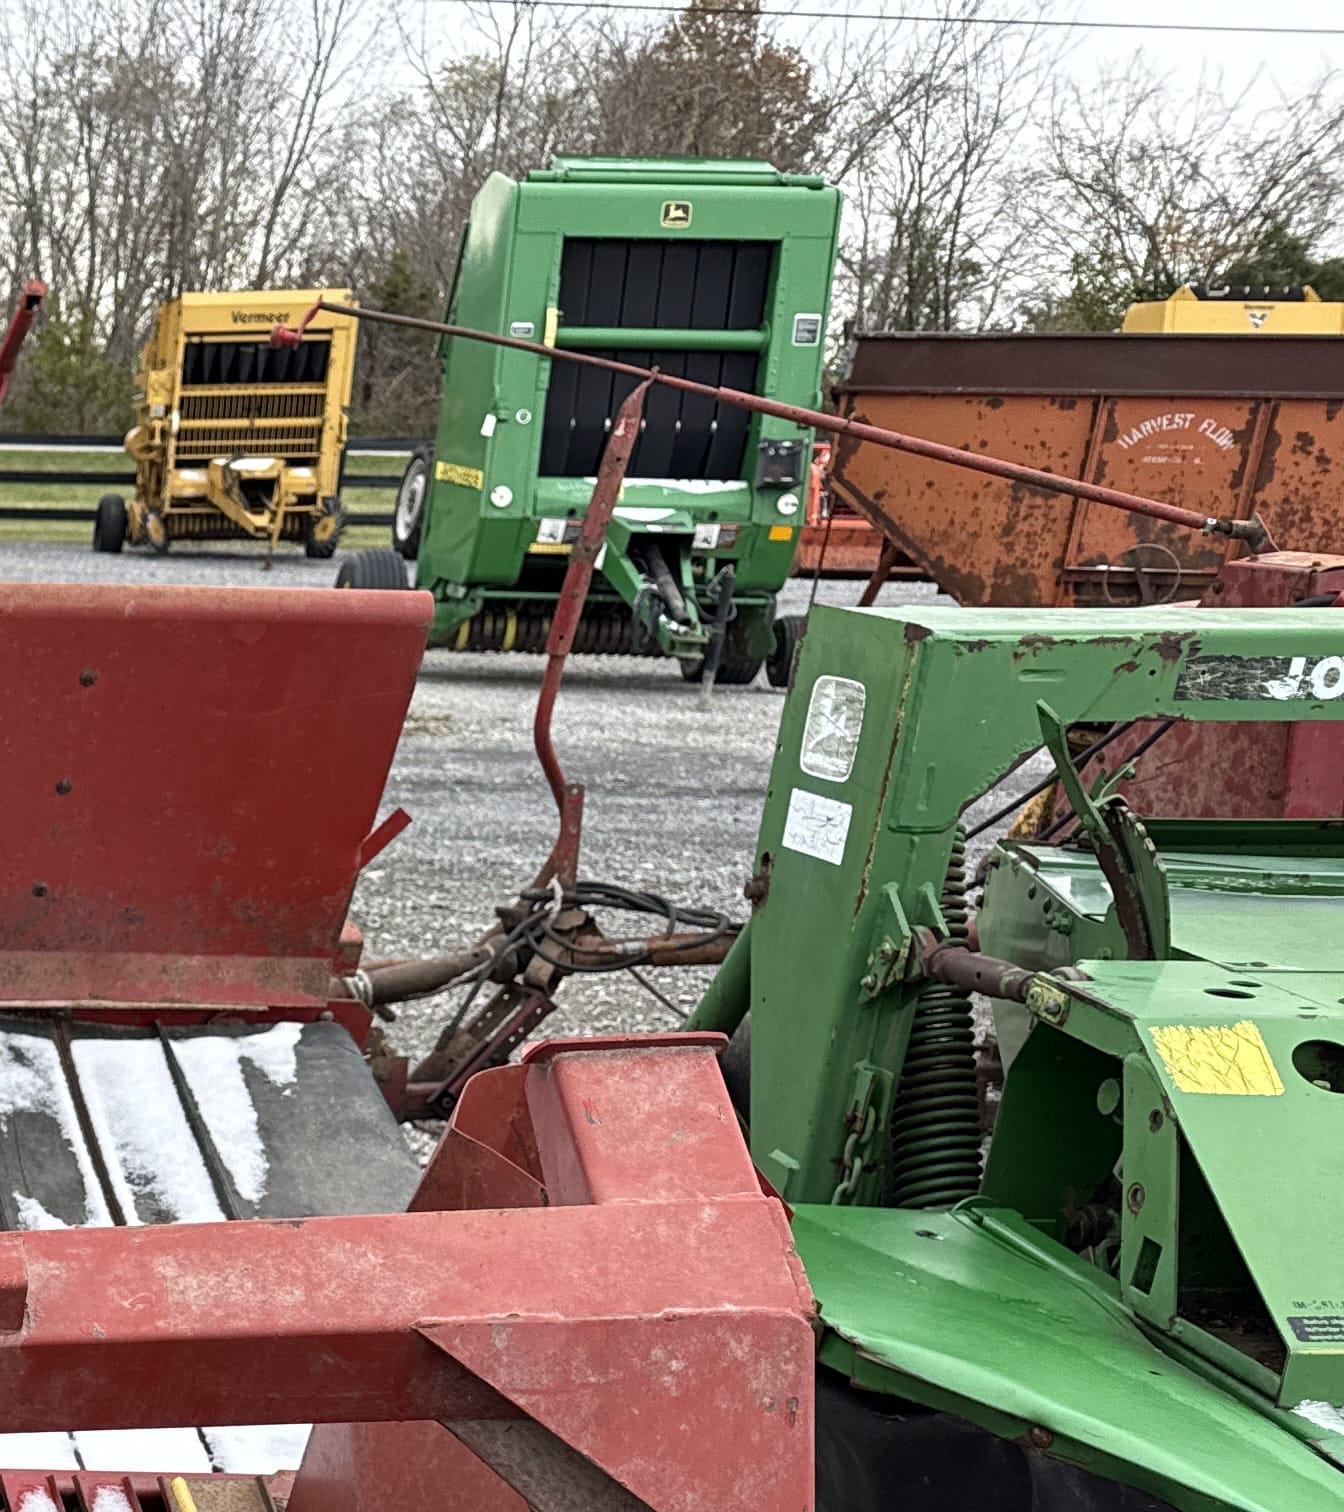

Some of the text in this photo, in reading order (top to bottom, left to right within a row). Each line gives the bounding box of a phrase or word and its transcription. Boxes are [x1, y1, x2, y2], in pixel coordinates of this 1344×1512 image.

[231, 310, 290, 323] Vermeer
[1117, 413, 1235, 451] HARVEST FLOW
[1264, 656, 1344, 700] JO
